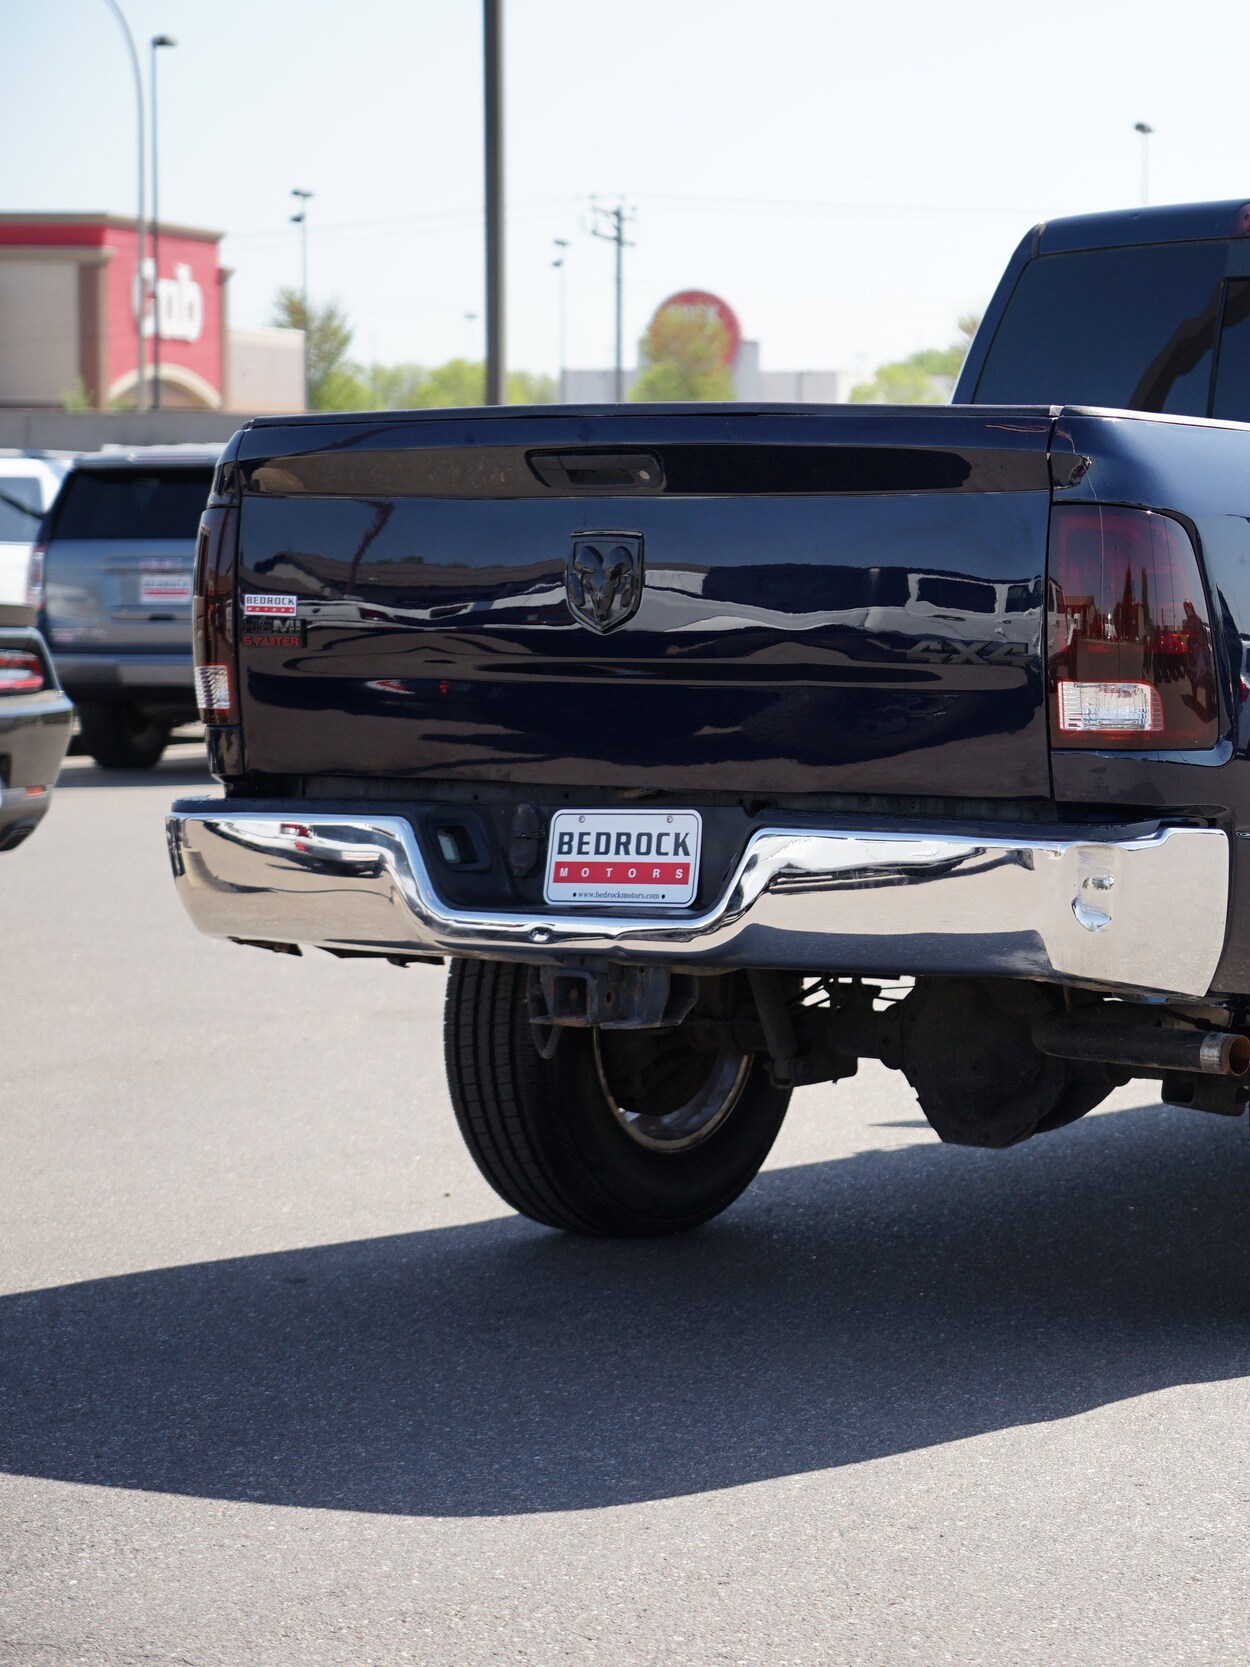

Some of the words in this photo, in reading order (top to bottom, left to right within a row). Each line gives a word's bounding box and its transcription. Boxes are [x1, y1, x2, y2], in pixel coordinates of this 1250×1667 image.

[246, 596, 295, 606] BEDROCK
[557, 831, 691, 857] BEDROCK
[559, 867, 684, 879] MOTORS
[577, 890, 660, 900] www.bedrockmotors.com
